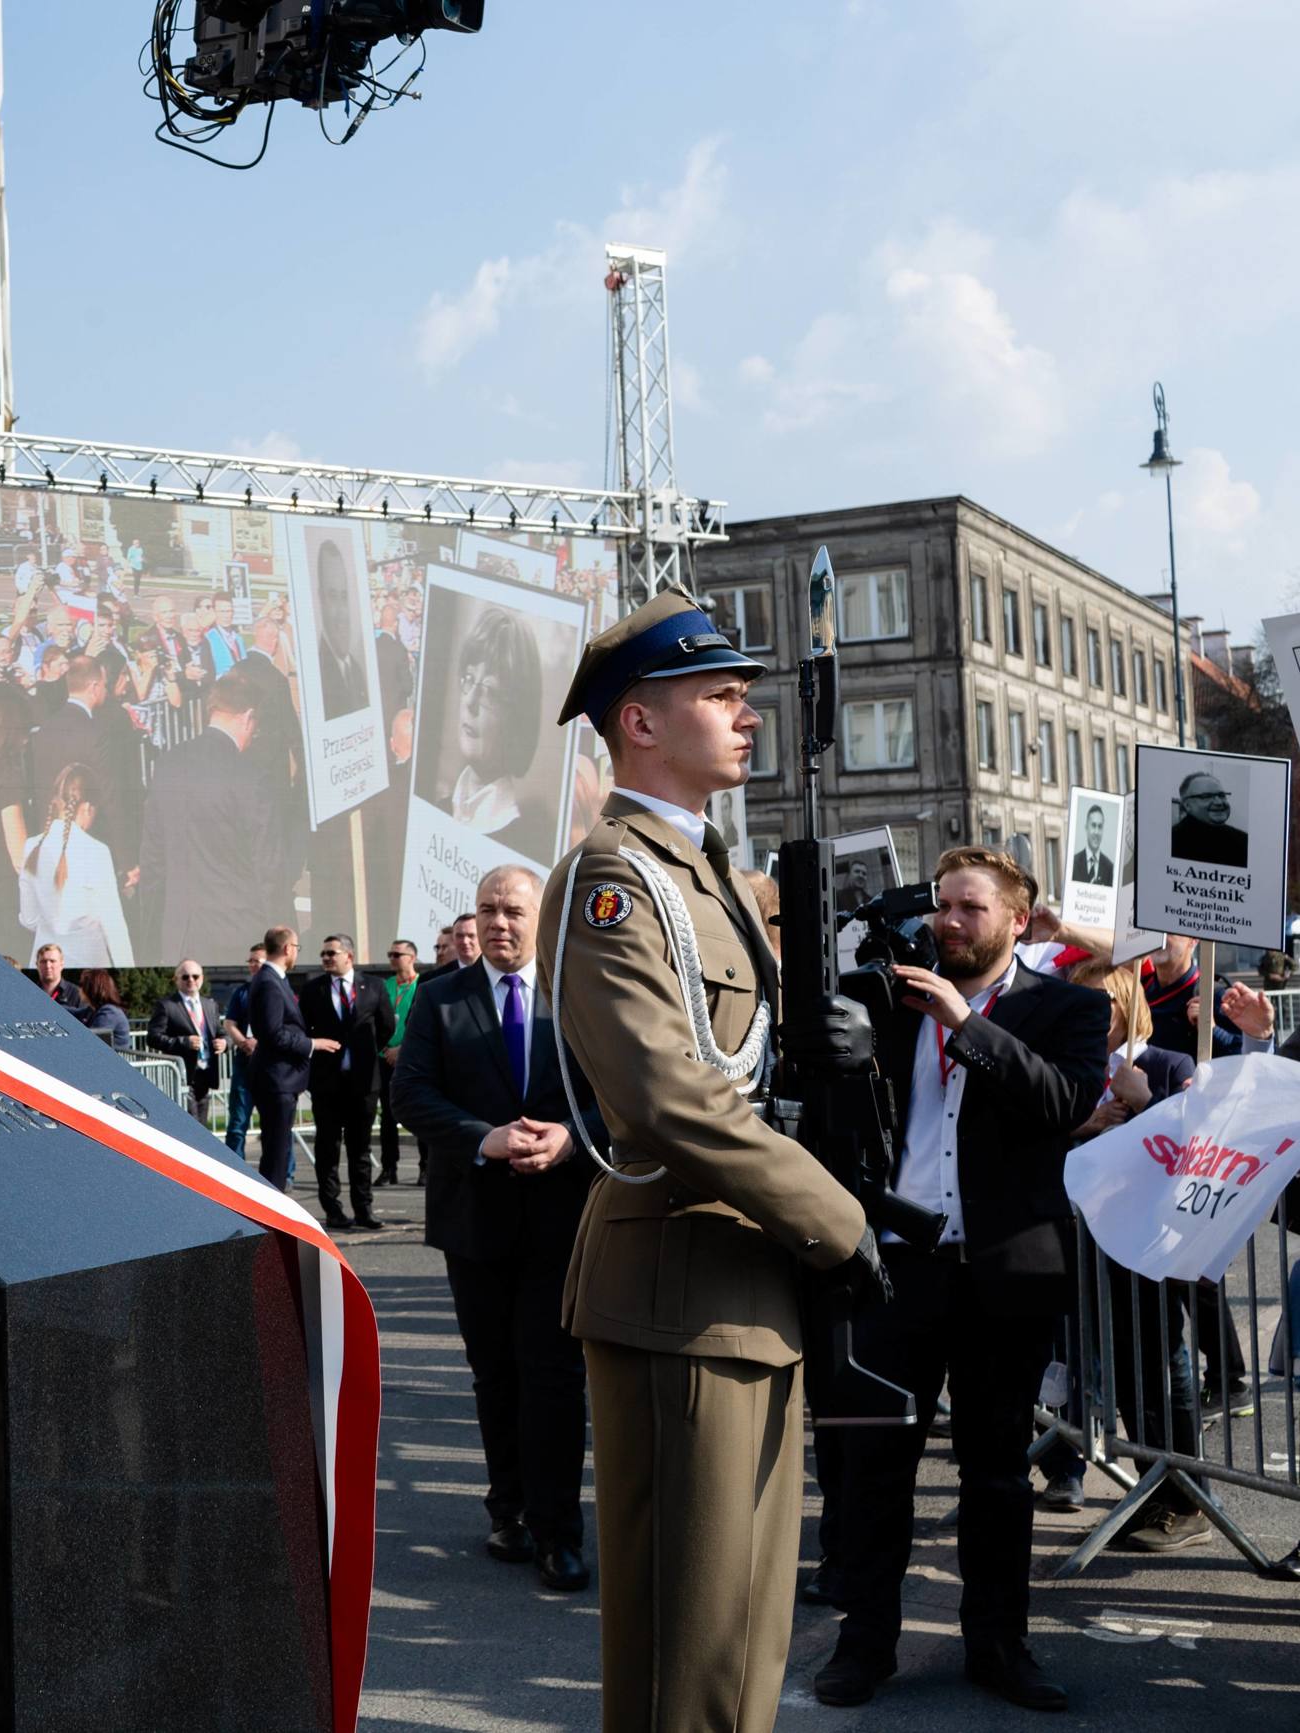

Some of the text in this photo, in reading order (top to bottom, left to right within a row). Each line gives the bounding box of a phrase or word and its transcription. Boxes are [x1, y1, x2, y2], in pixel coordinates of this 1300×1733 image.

[427, 833, 480, 886] Aleksa
[418, 863, 471, 915] Natalli
[1166, 865, 1251, 890] ks. Andrzej
[1172, 880, 1245, 904] Kwaśnik
[1164, 904, 1252, 928] Federacji Rodzin
[1186, 898, 1230, 913] Kapelan
[1178, 918, 1237, 935] Katyńskich
